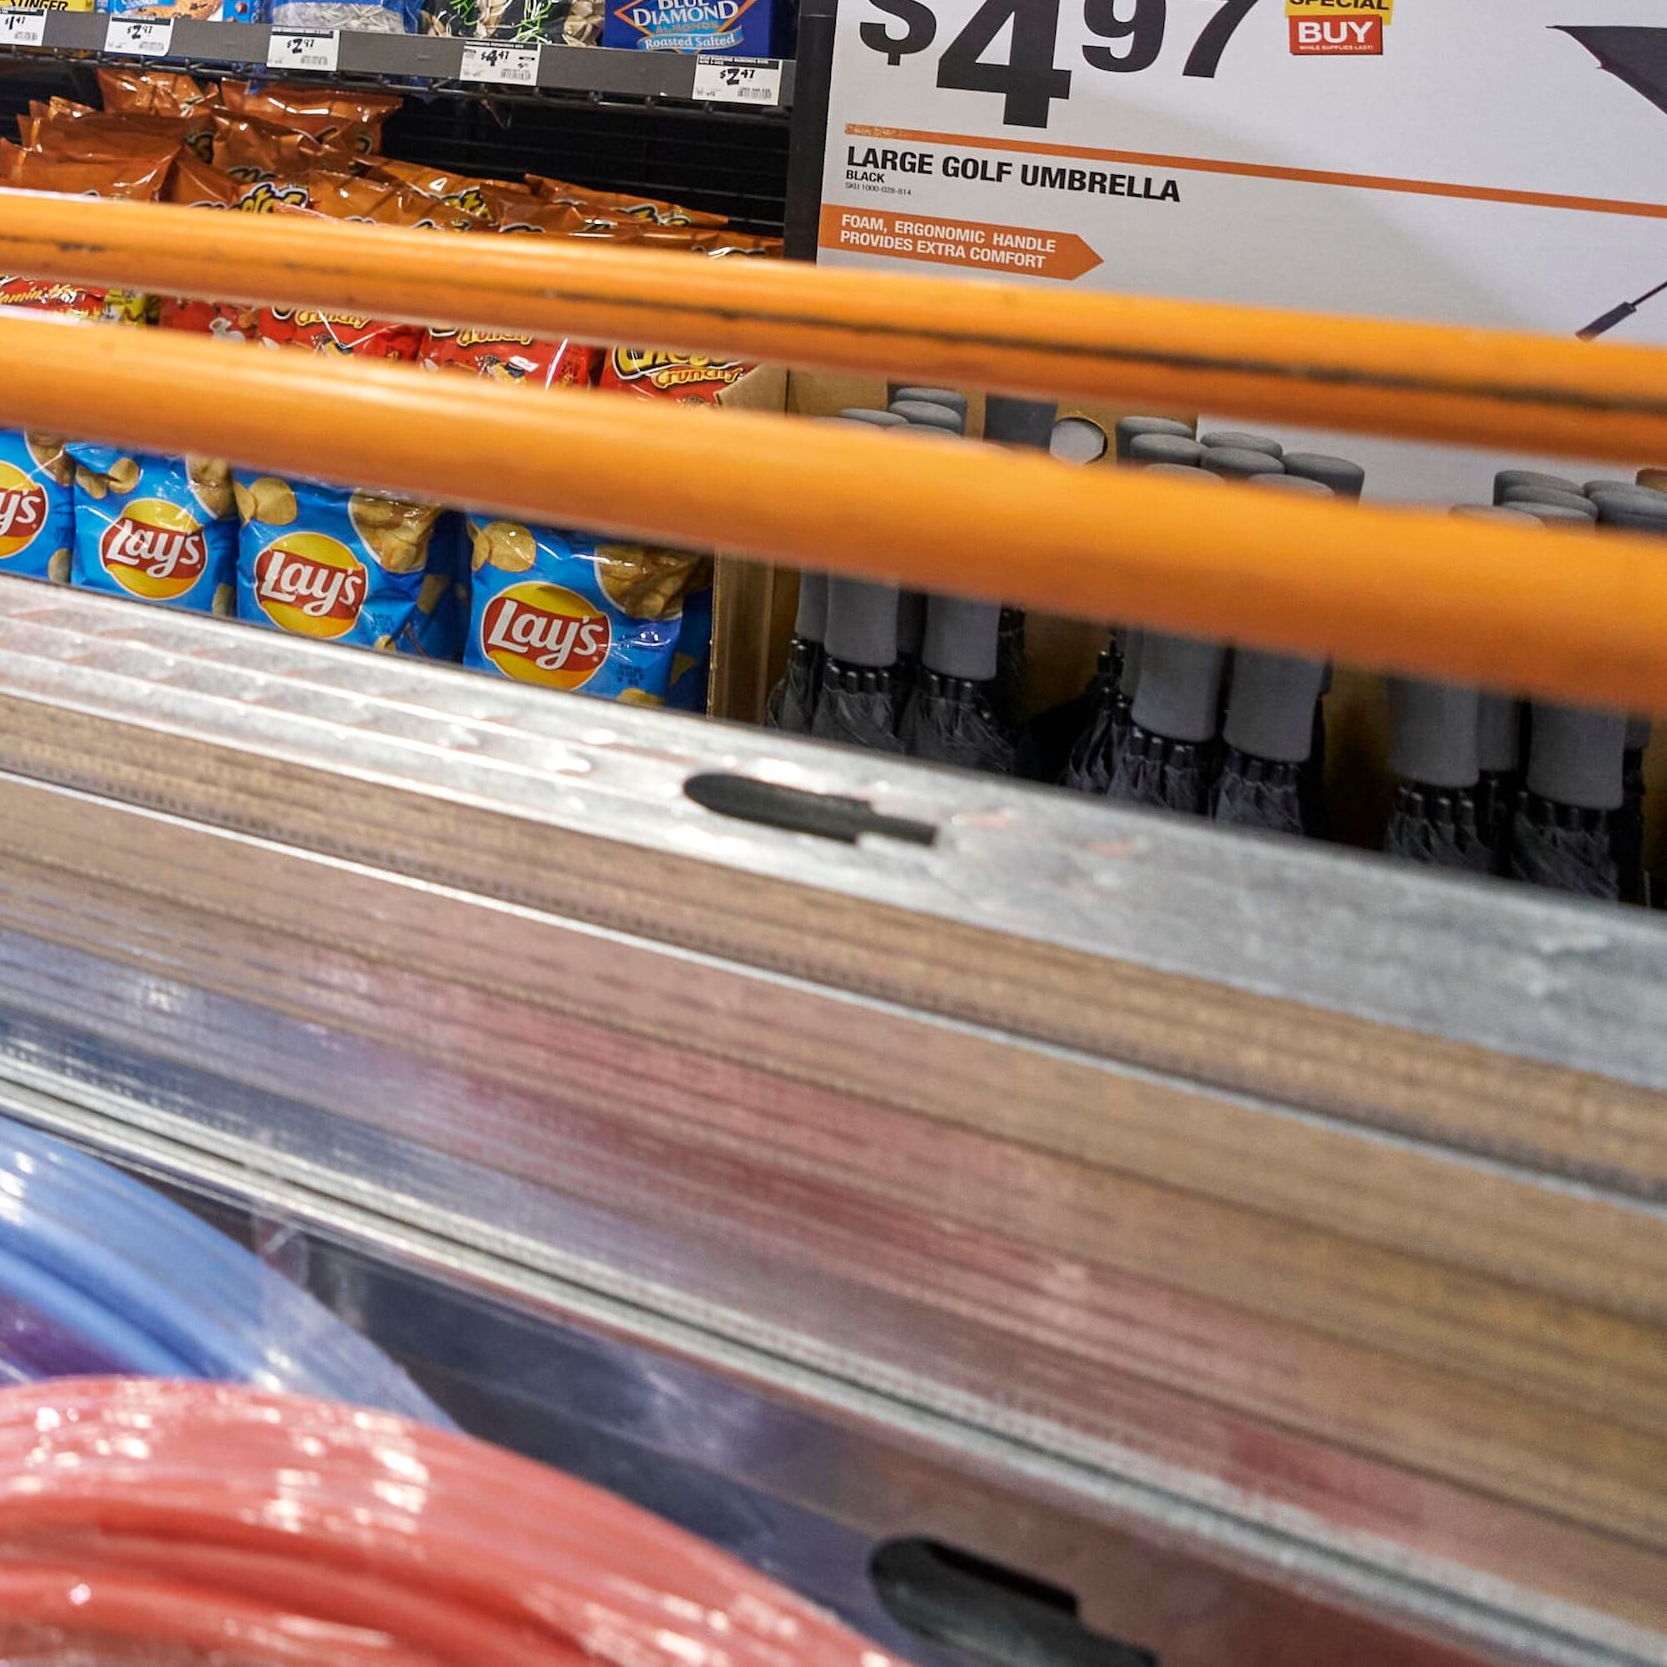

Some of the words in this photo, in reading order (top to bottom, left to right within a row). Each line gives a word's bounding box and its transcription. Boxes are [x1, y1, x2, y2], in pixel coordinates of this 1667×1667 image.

[633, 0, 739, 28] DIAMOND
[1298, 21, 1373, 44] BUY
[645, 36, 693, 49] Roasted
[695, 34, 736, 48] Salted
[846, 169, 885, 185] BLACK
[847, 145, 934, 176] LARGE
[941, 155, 1013, 184] GOLF
[1020, 164, 1181, 203] UMBRELLA
[840, 230, 914, 252] PROVIDES
[916, 240, 966, 260] EXTRA
[969, 247, 1047, 270] COMFORT
[841, 213, 888, 233] FOAM,
[894, 220, 986, 245] ERGONOMIC
[992, 233, 1057, 254] HANDLE
[650, 366, 744, 390] Crunchy
[105, 520, 201, 580] Lay's
[261, 549, 363, 617] Lay's
[486, 599, 604, 671] Lay's
